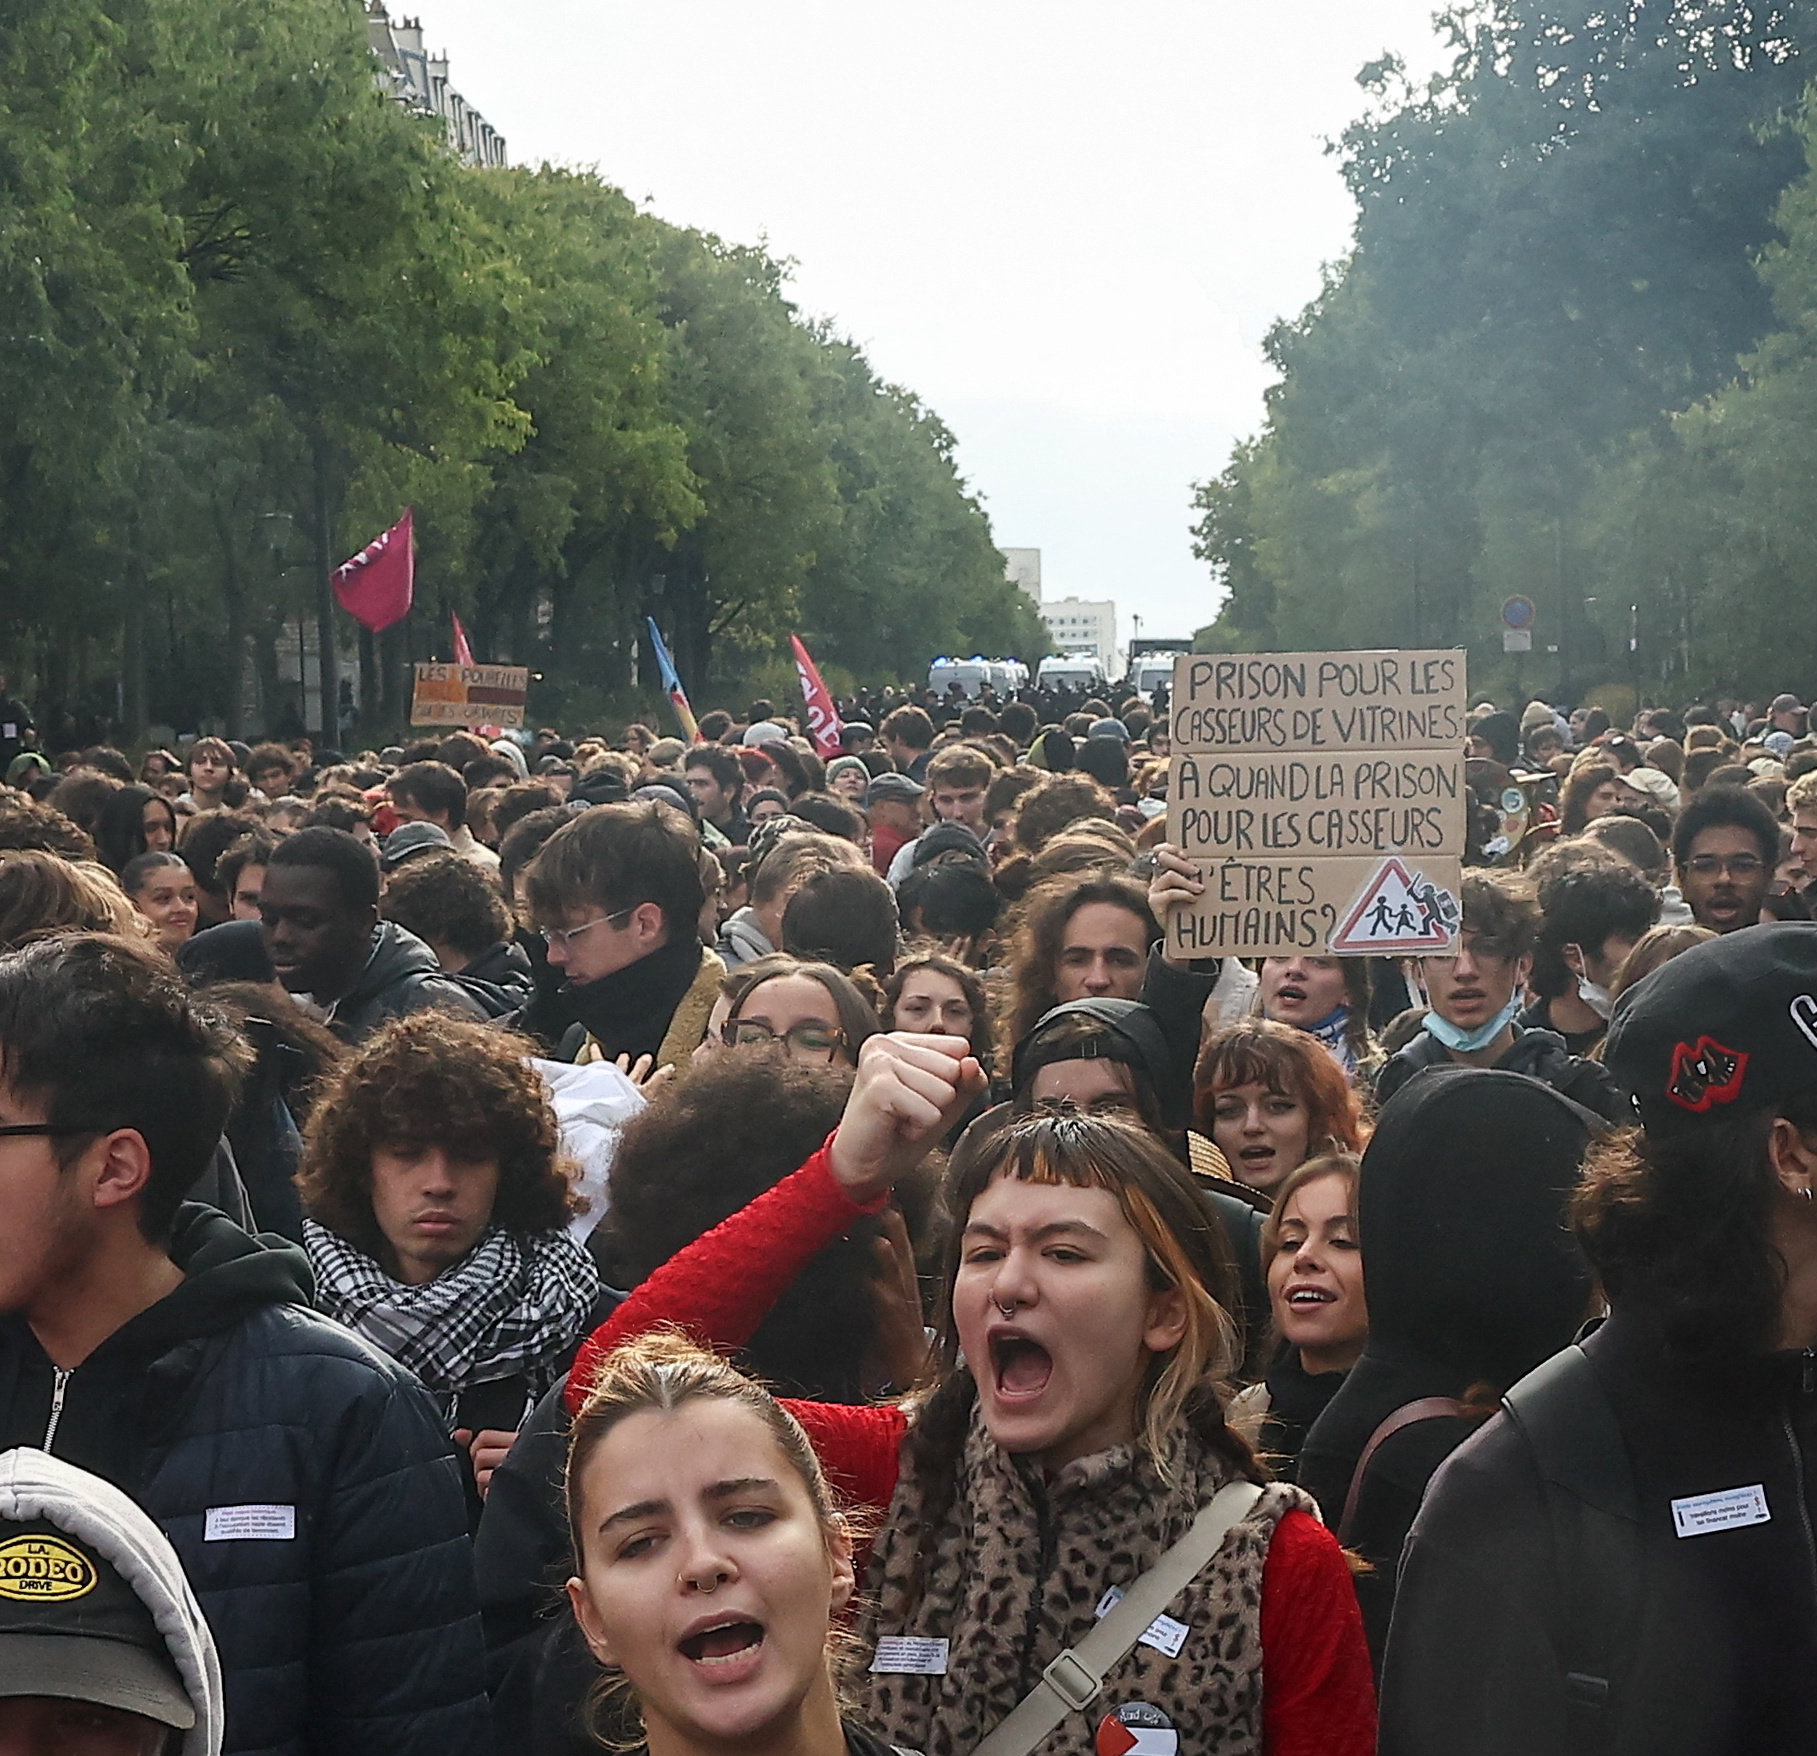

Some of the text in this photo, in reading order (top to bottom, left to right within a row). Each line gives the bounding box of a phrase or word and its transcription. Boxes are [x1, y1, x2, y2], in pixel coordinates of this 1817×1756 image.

[1190, 658, 1455, 700] PRISON POUR LES
[1175, 706, 1286, 746] CASSEURS
[1293, 707, 1326, 745] DE
[1178, 754, 1457, 801] À QUAND LA PRISON
[1181, 807, 1444, 850] POUR LES CASSEURS
[1195, 857, 1315, 904] 'ÊTRES
[1176, 903, 1337, 953] HUMAINS?
[19, 1580, 53, 1591] DRIVE
